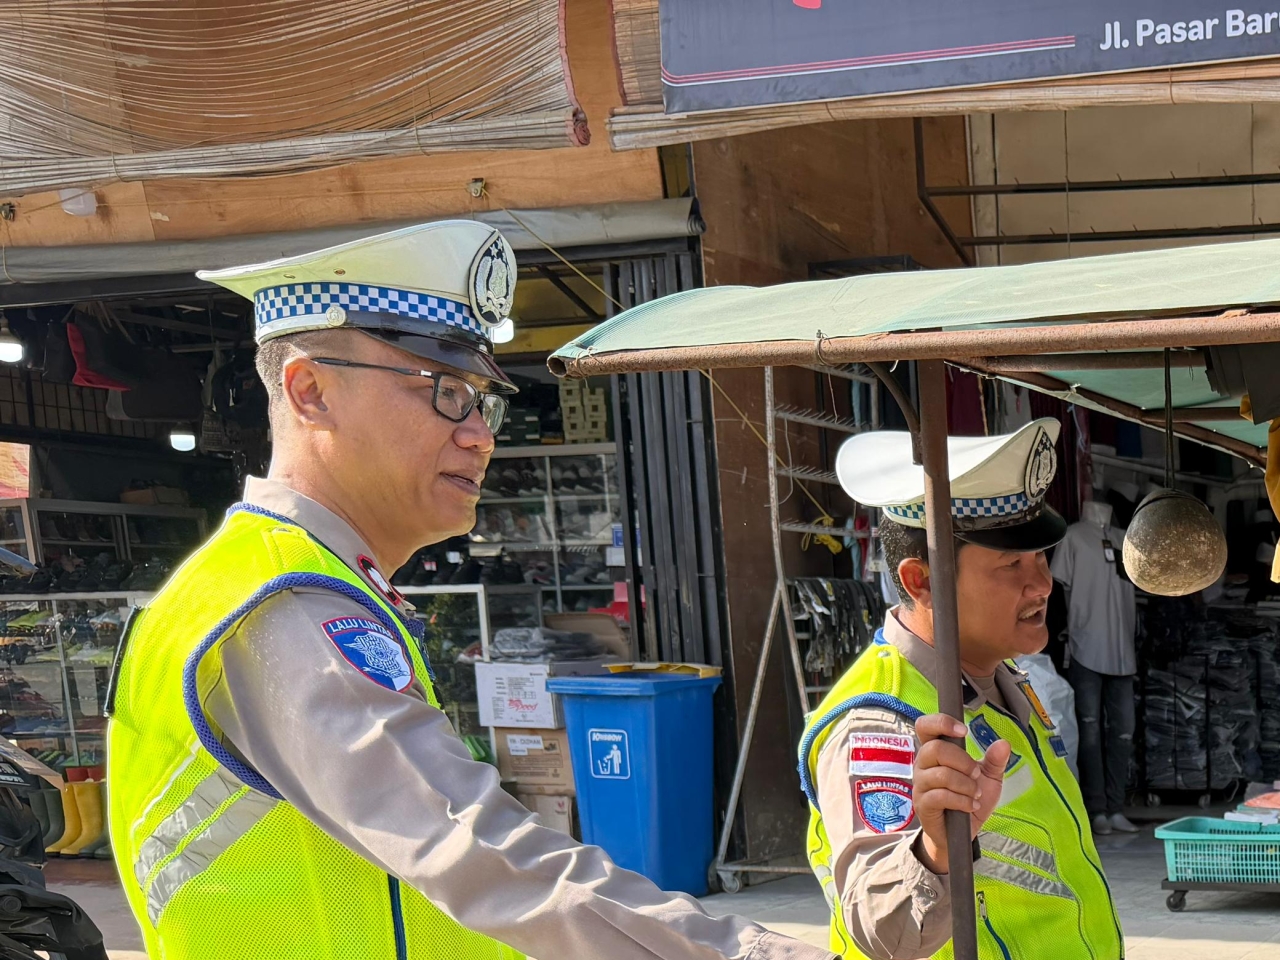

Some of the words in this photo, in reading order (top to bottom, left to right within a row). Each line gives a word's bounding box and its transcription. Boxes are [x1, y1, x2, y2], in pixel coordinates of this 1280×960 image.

[1099, 21, 1130, 51] Jl.
[1136, 18, 1219, 47] Pasar
[328, 618, 359, 633] LALU
[853, 736, 910, 748] INDONESIA
[860, 781, 882, 790] LALU
[882, 781, 909, 793] LINTAS
